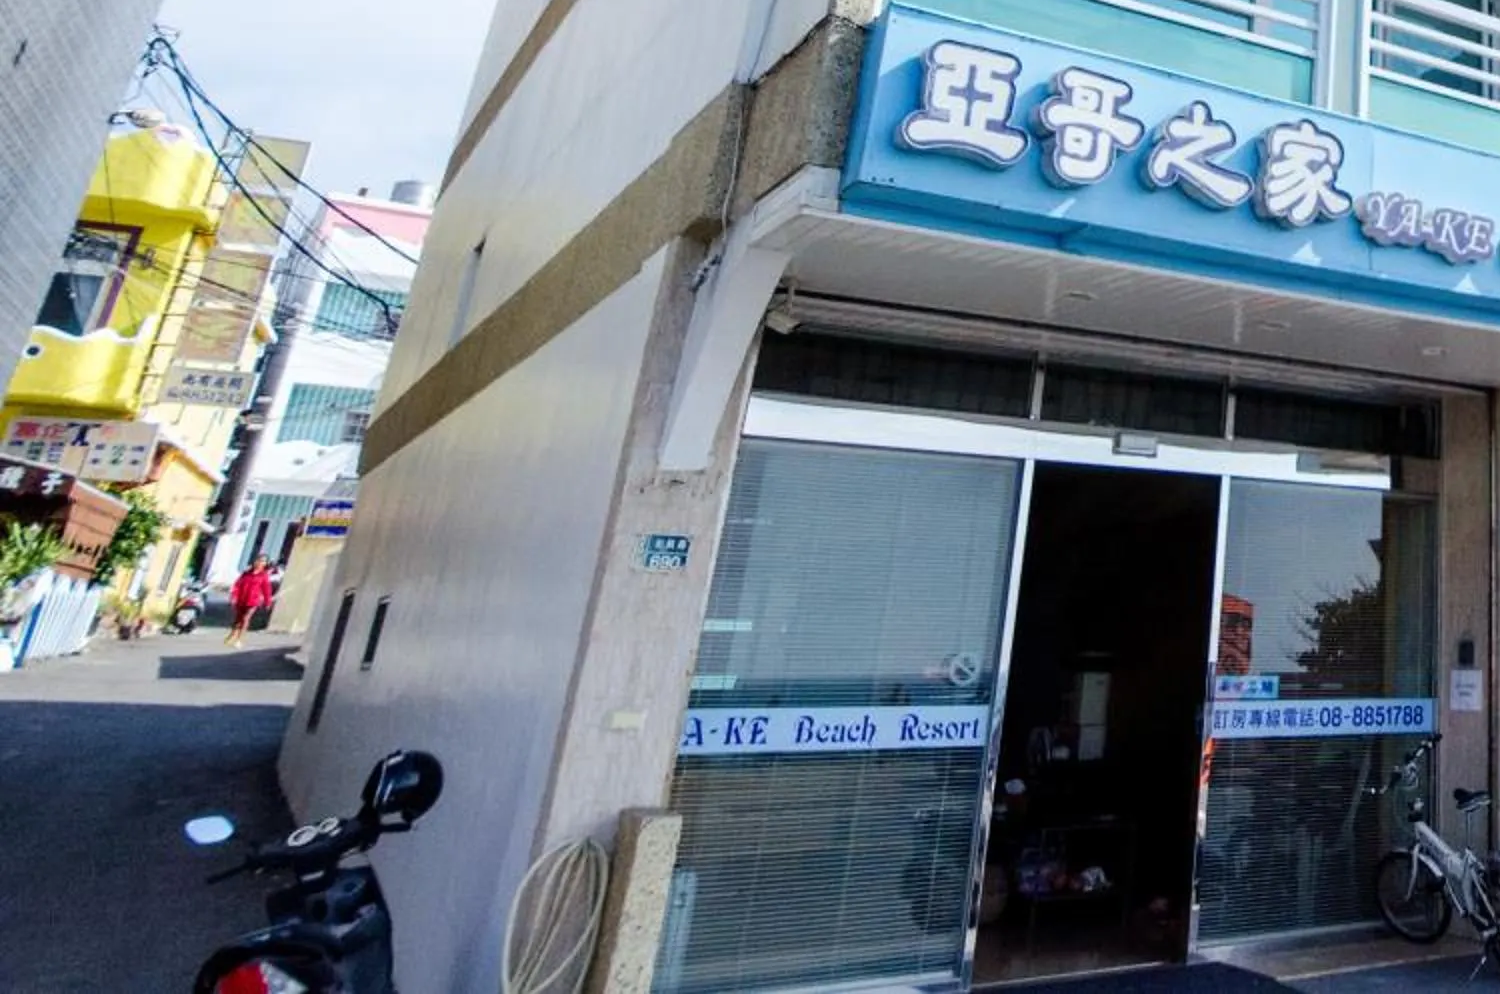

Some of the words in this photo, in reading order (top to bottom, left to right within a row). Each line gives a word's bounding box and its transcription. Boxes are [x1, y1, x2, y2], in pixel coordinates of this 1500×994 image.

[900, 39, 1354, 228] 亞哥之家
[1361, 191, 1495, 262] YA-KE
[794, 713, 877, 747] Beach
[898, 712, 979, 743] Resort
